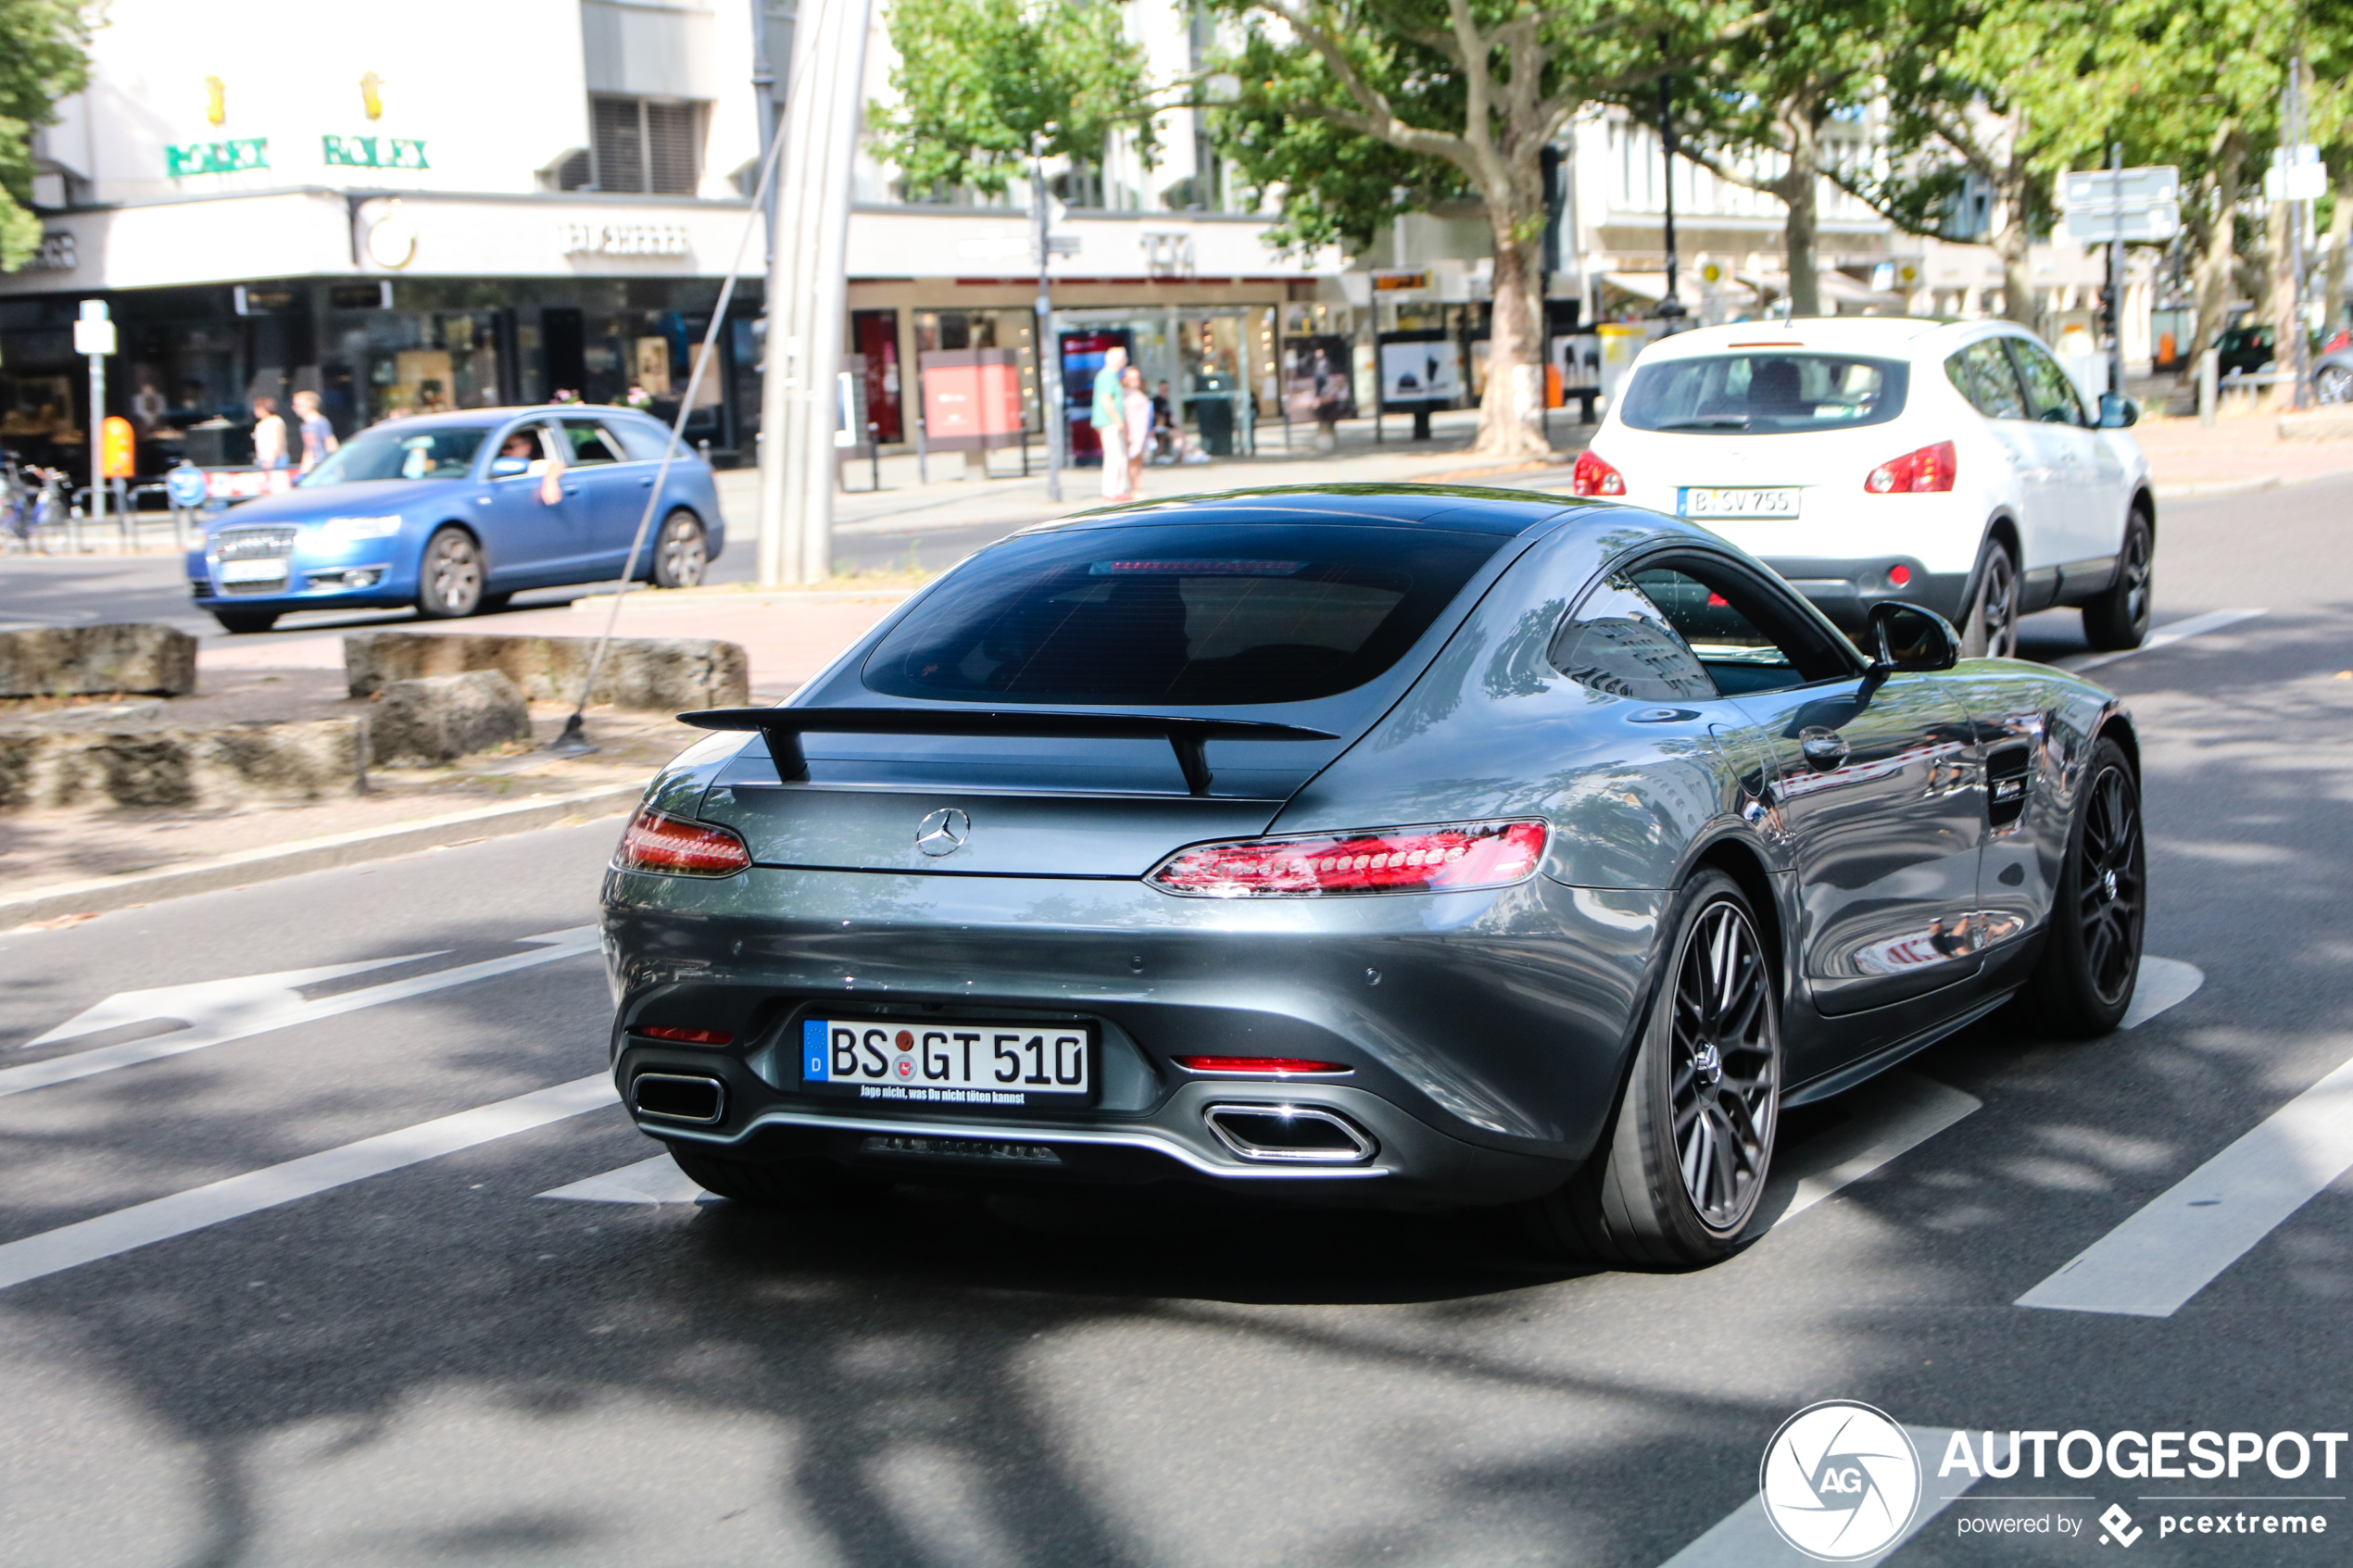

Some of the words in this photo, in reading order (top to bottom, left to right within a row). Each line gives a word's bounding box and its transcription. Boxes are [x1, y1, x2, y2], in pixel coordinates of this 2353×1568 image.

[1695, 492, 1707, 511] B
[1722, 491, 1747, 511] SV
[1753, 491, 1789, 511] 755
[812, 1058, 822, 1073] D
[832, 1027, 889, 1078] BS
[923, 1031, 981, 1082] GT
[994, 1033, 1083, 1085] 510
[861, 1085, 881, 1099] Jage
[882, 1085, 908, 1100] nicht,
[908, 1088, 927, 1100] was
[927, 1087, 941, 1101] Du
[941, 1088, 966, 1102] nicht
[966, 1089, 991, 1102] töten
[991, 1091, 1026, 1104] kannst
